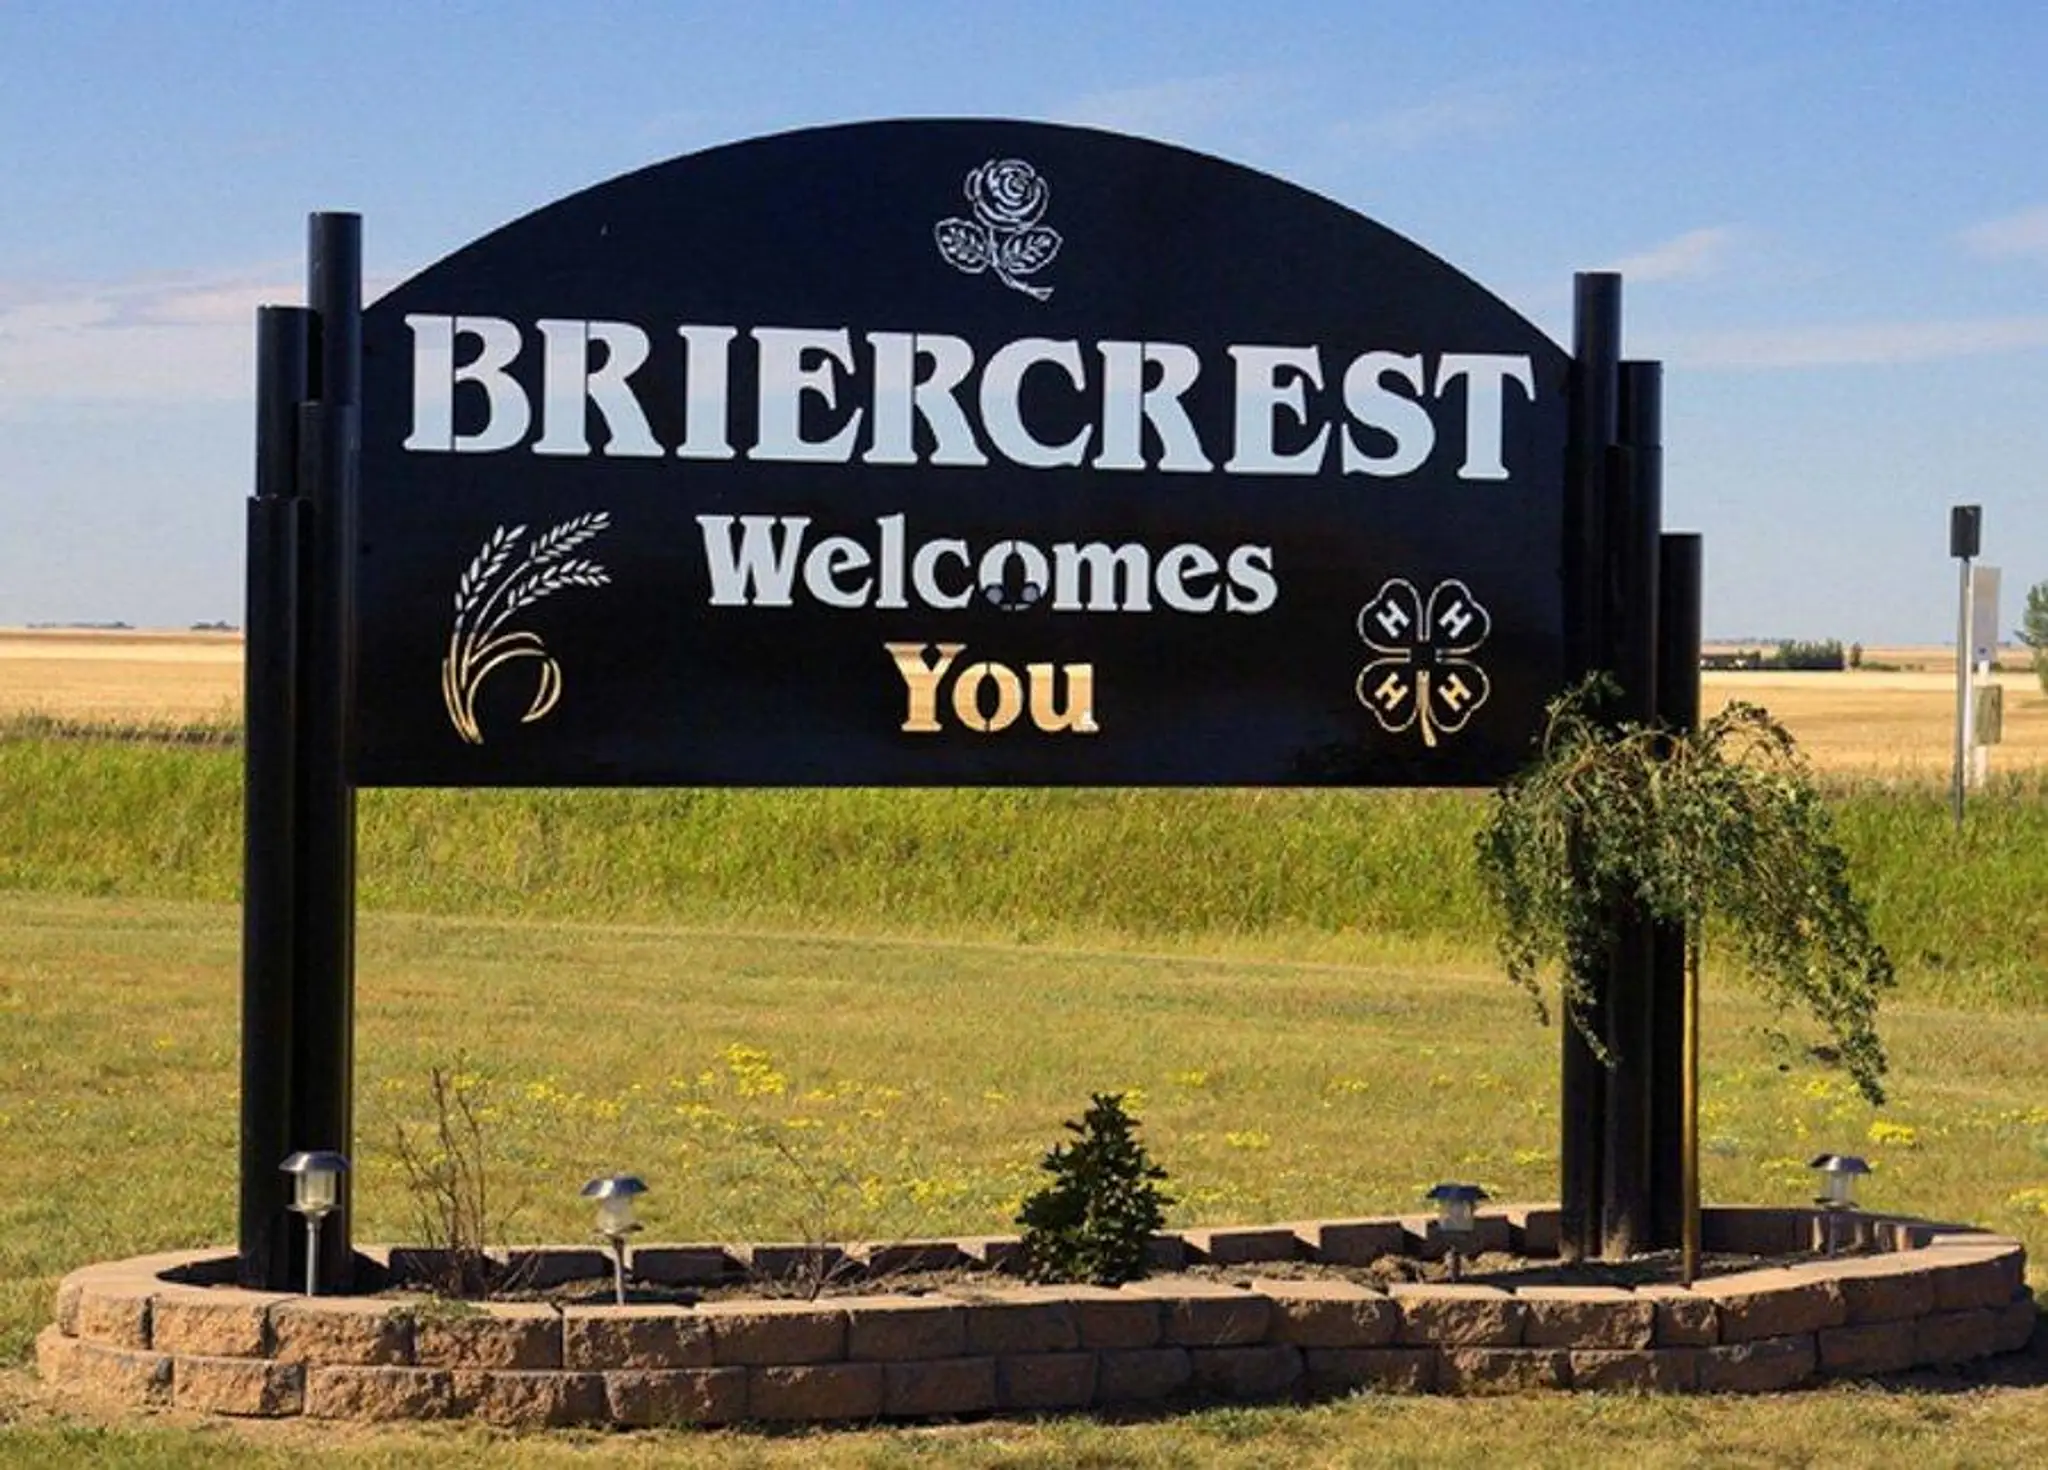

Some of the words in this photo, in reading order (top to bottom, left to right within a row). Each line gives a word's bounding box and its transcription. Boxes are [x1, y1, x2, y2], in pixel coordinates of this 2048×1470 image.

[403, 313, 1536, 481] BRIERCREST
[695, 513, 1278, 613] Welcomes
[1376, 599, 1411, 638] H
[1438, 600, 1473, 639] H
[884, 642, 1100, 733] You
[1374, 672, 1409, 711] H
[1438, 672, 1473, 712] H
